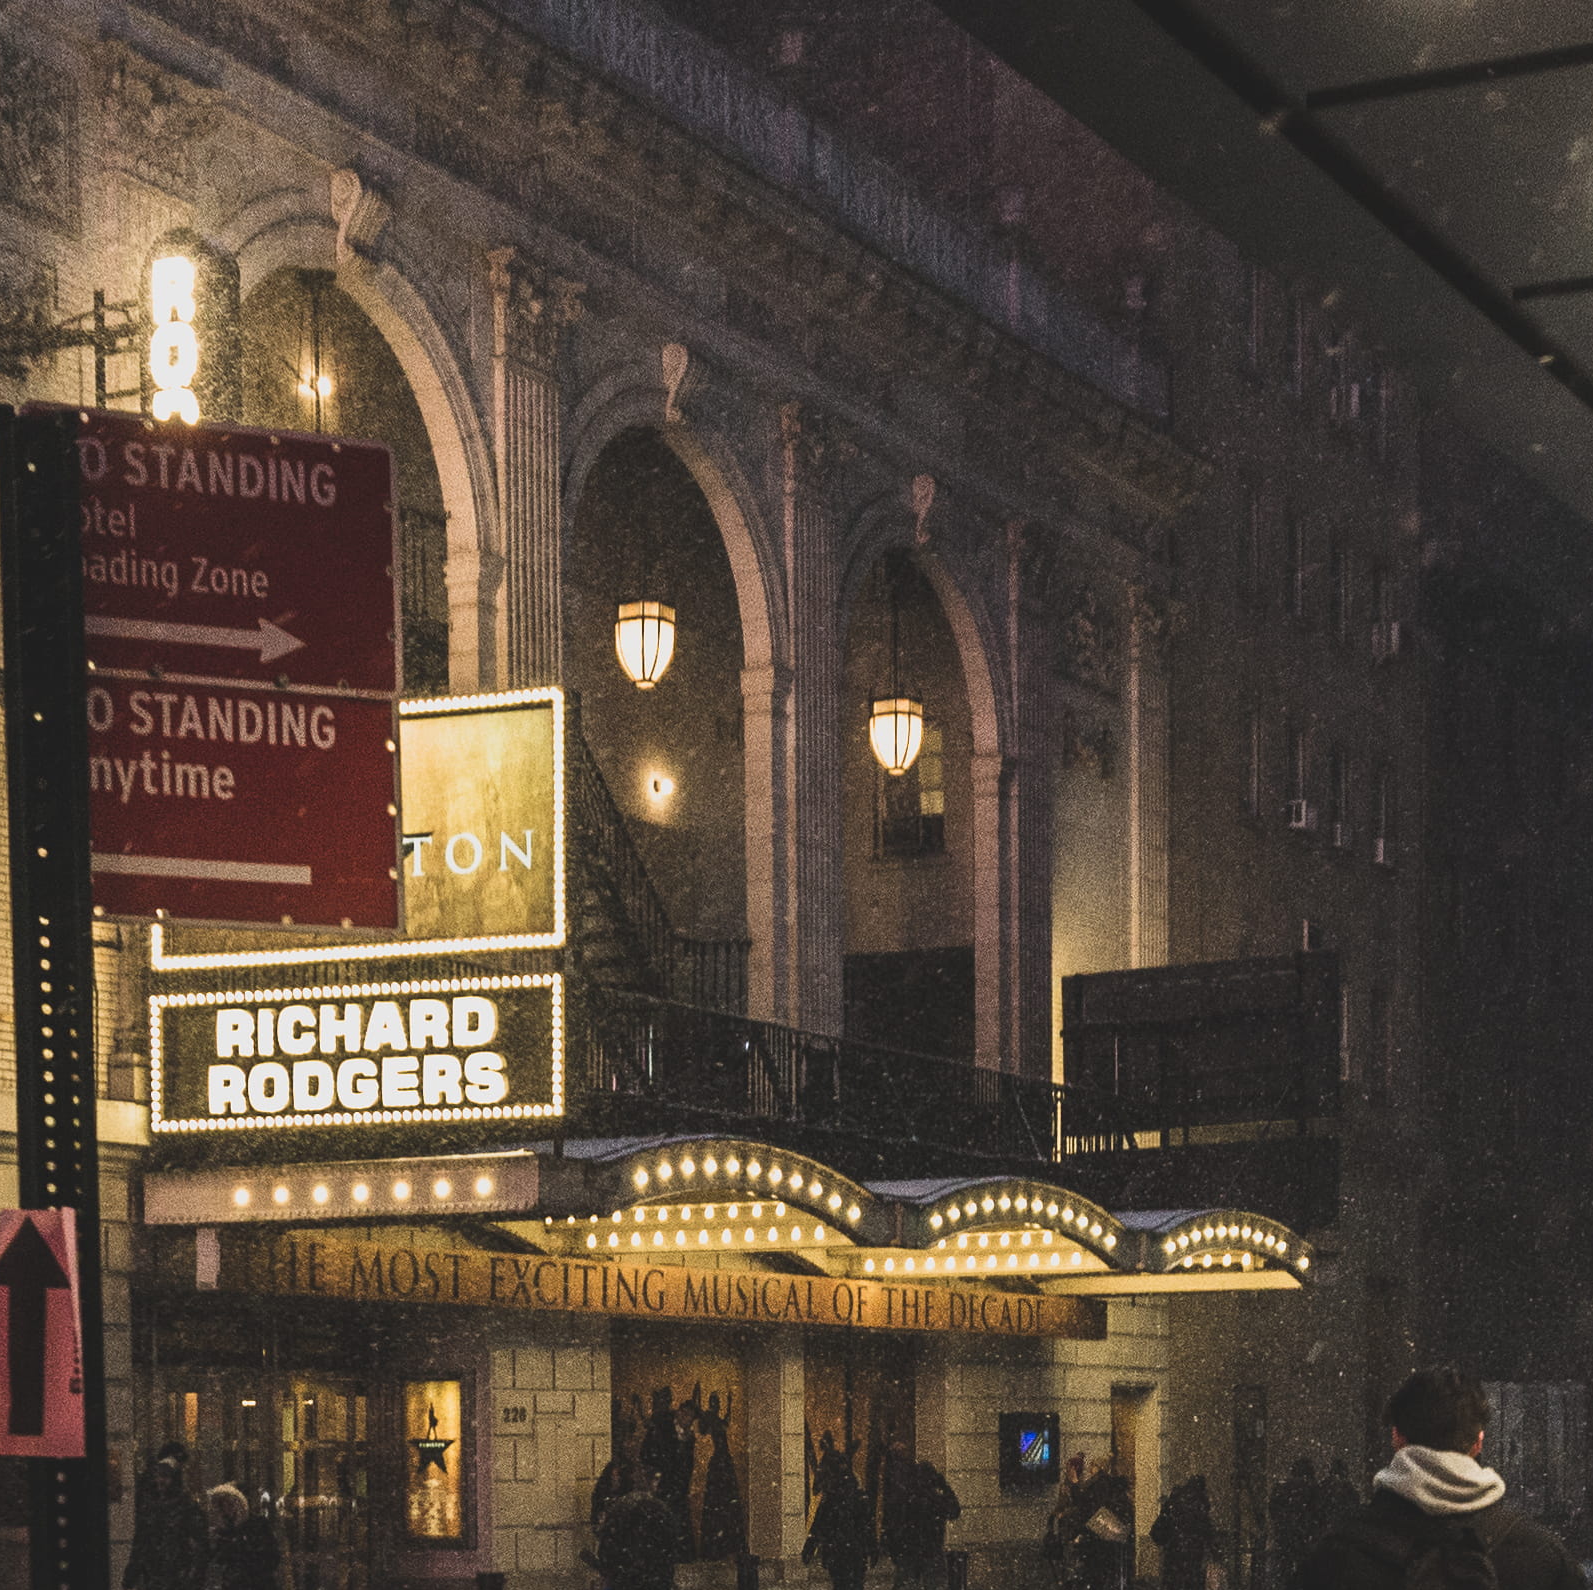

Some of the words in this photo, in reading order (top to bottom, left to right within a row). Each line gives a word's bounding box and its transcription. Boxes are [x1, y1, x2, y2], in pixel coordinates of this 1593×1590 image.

[80, 439, 107, 480] O
[123, 444, 338, 507] STANDING
[80, 498, 136, 539] otel
[81, 549, 178, 597] ading
[190, 556, 269, 598] Zone
[87, 688, 113, 732] O
[129, 690, 337, 750] STANDING
[89, 750, 235, 803] nytime
[216, 996, 498, 1057] RICHARD
[208, 1051, 508, 1114] RODGERS
[351, 1249, 467, 1299] MOST
[490, 1256, 664, 1311] EXCITING
[684, 1273, 818, 1320] MUSICAL
[832, 1283, 868, 1325] OF
[883, 1286, 934, 1327] THE
[950, 1292, 1045, 1333] DECADE
